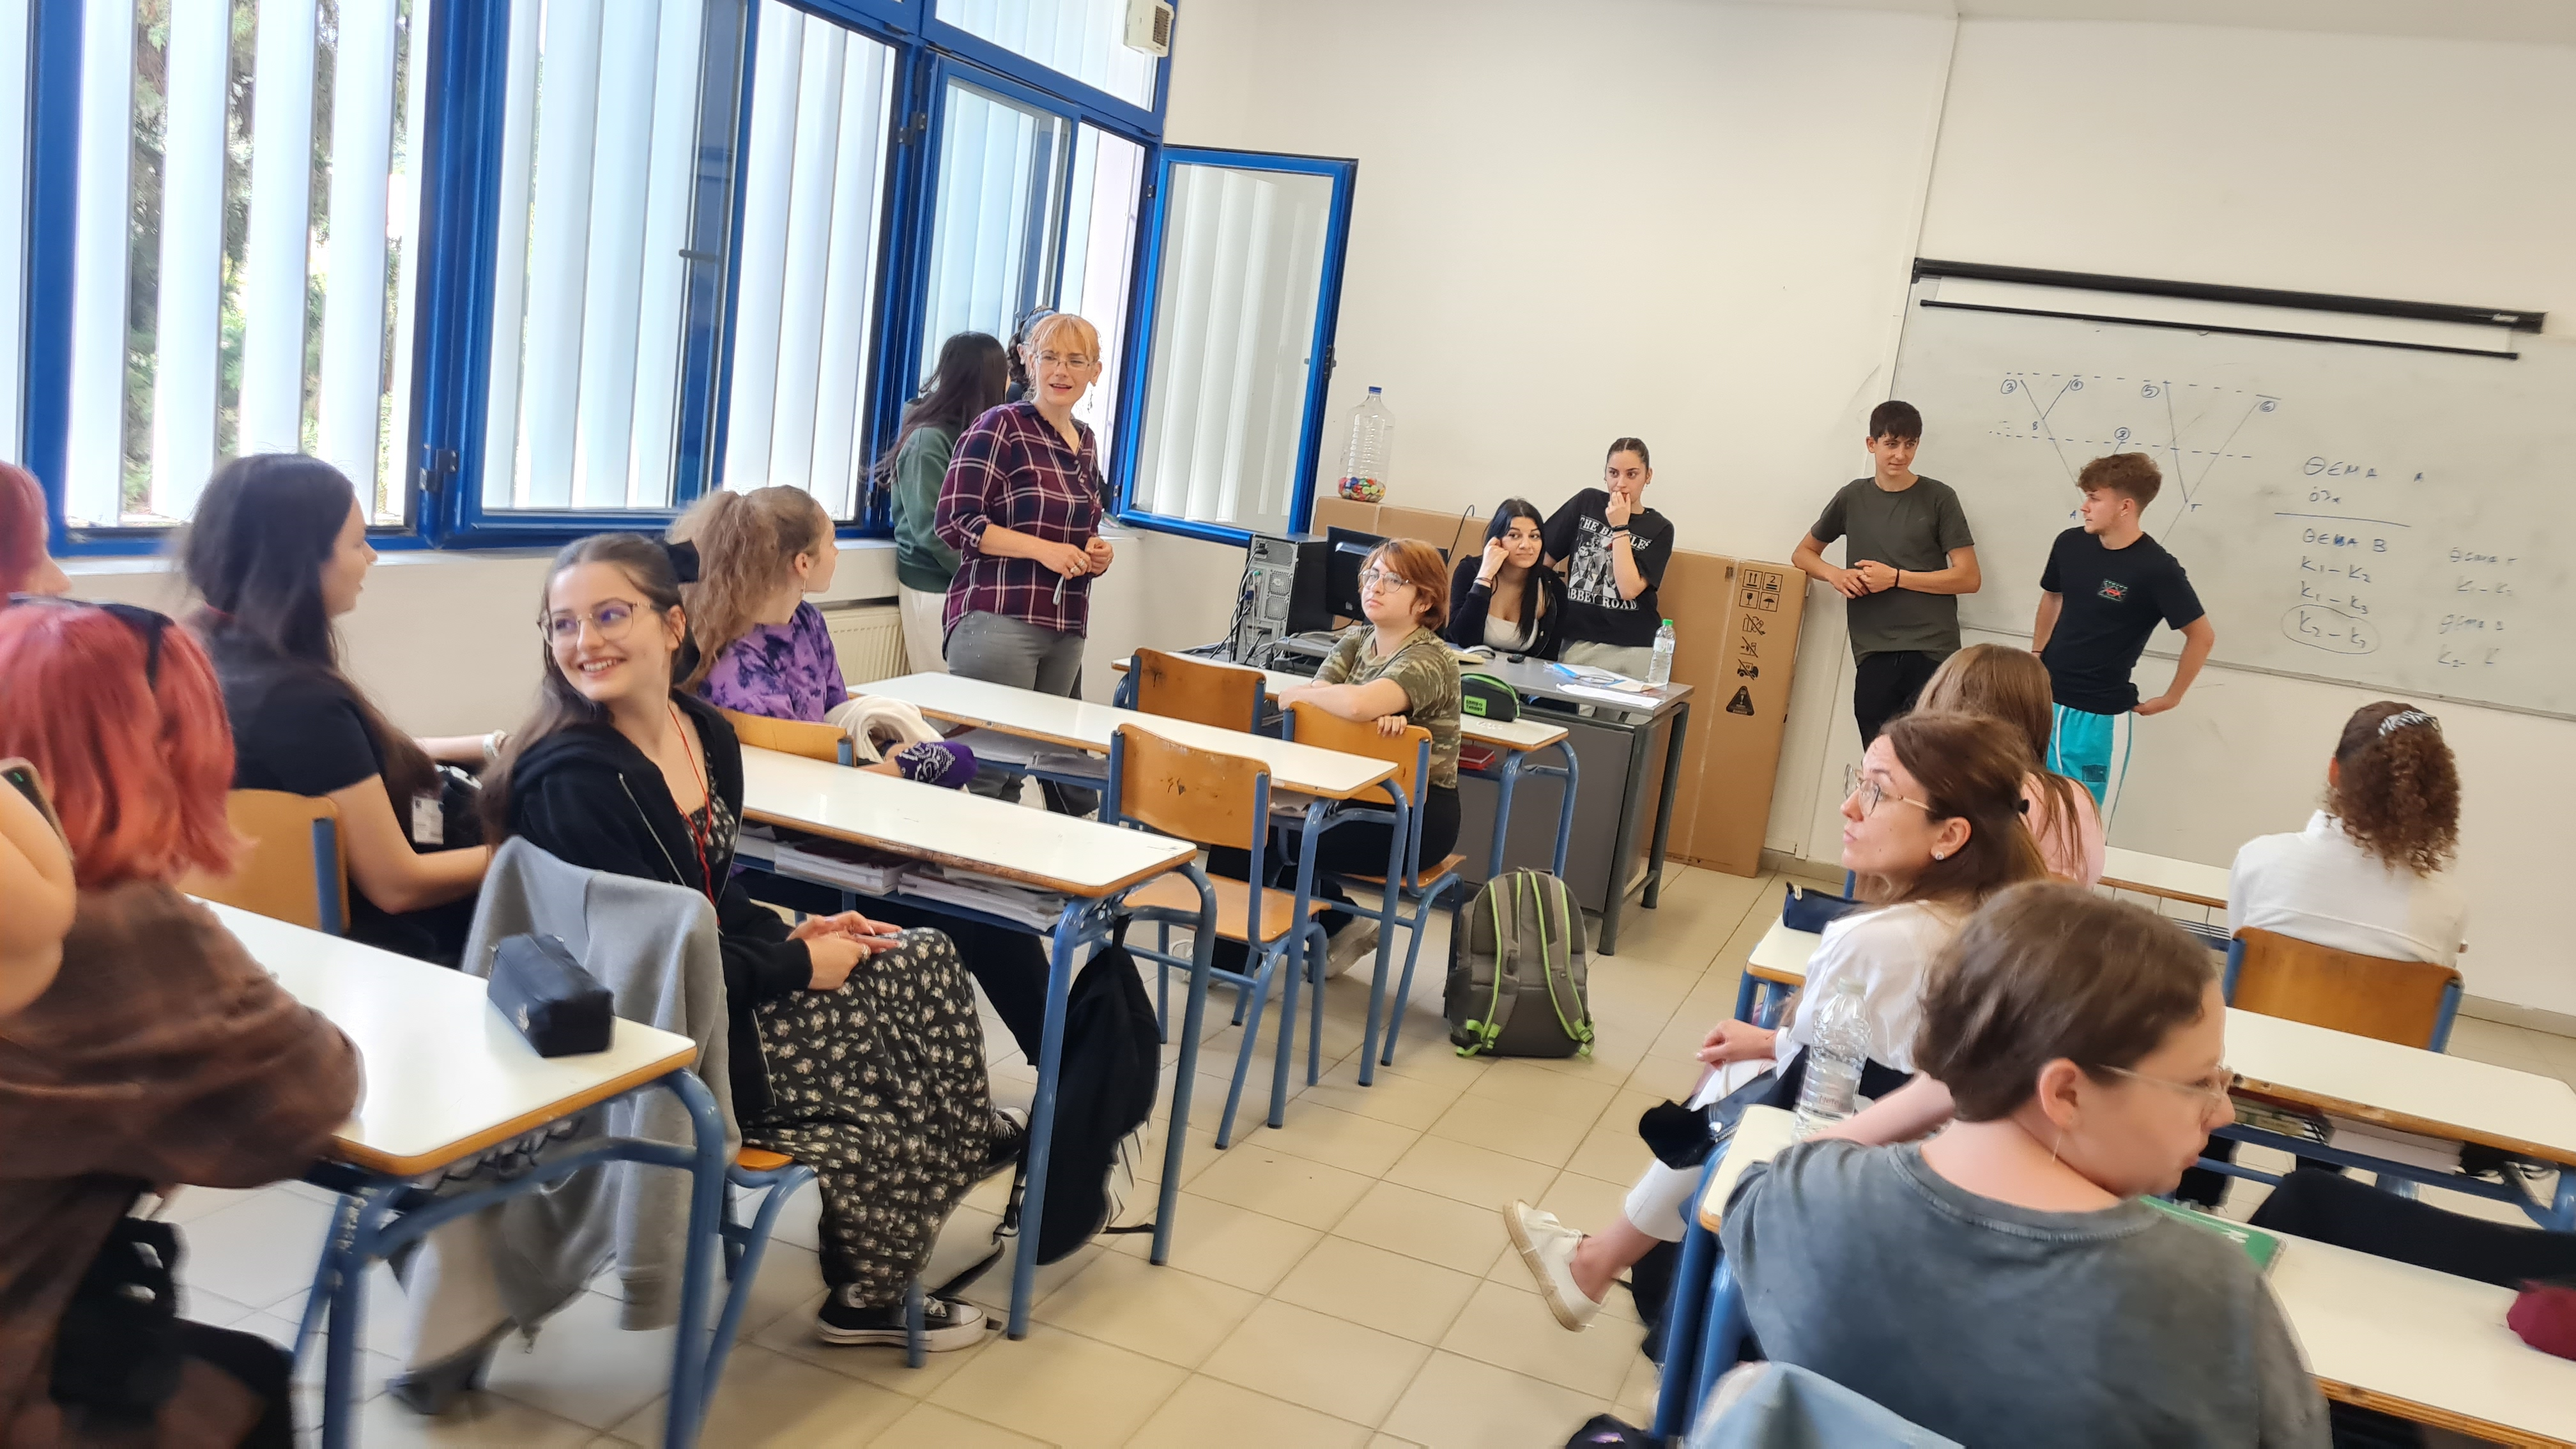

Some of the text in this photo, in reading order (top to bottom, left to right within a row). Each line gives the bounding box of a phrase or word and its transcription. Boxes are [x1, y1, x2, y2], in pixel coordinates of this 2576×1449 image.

[1580, 516, 1599, 532] THE
[1770, 575, 1775, 583] 2
[1602, 596, 1637, 610] ROAD
